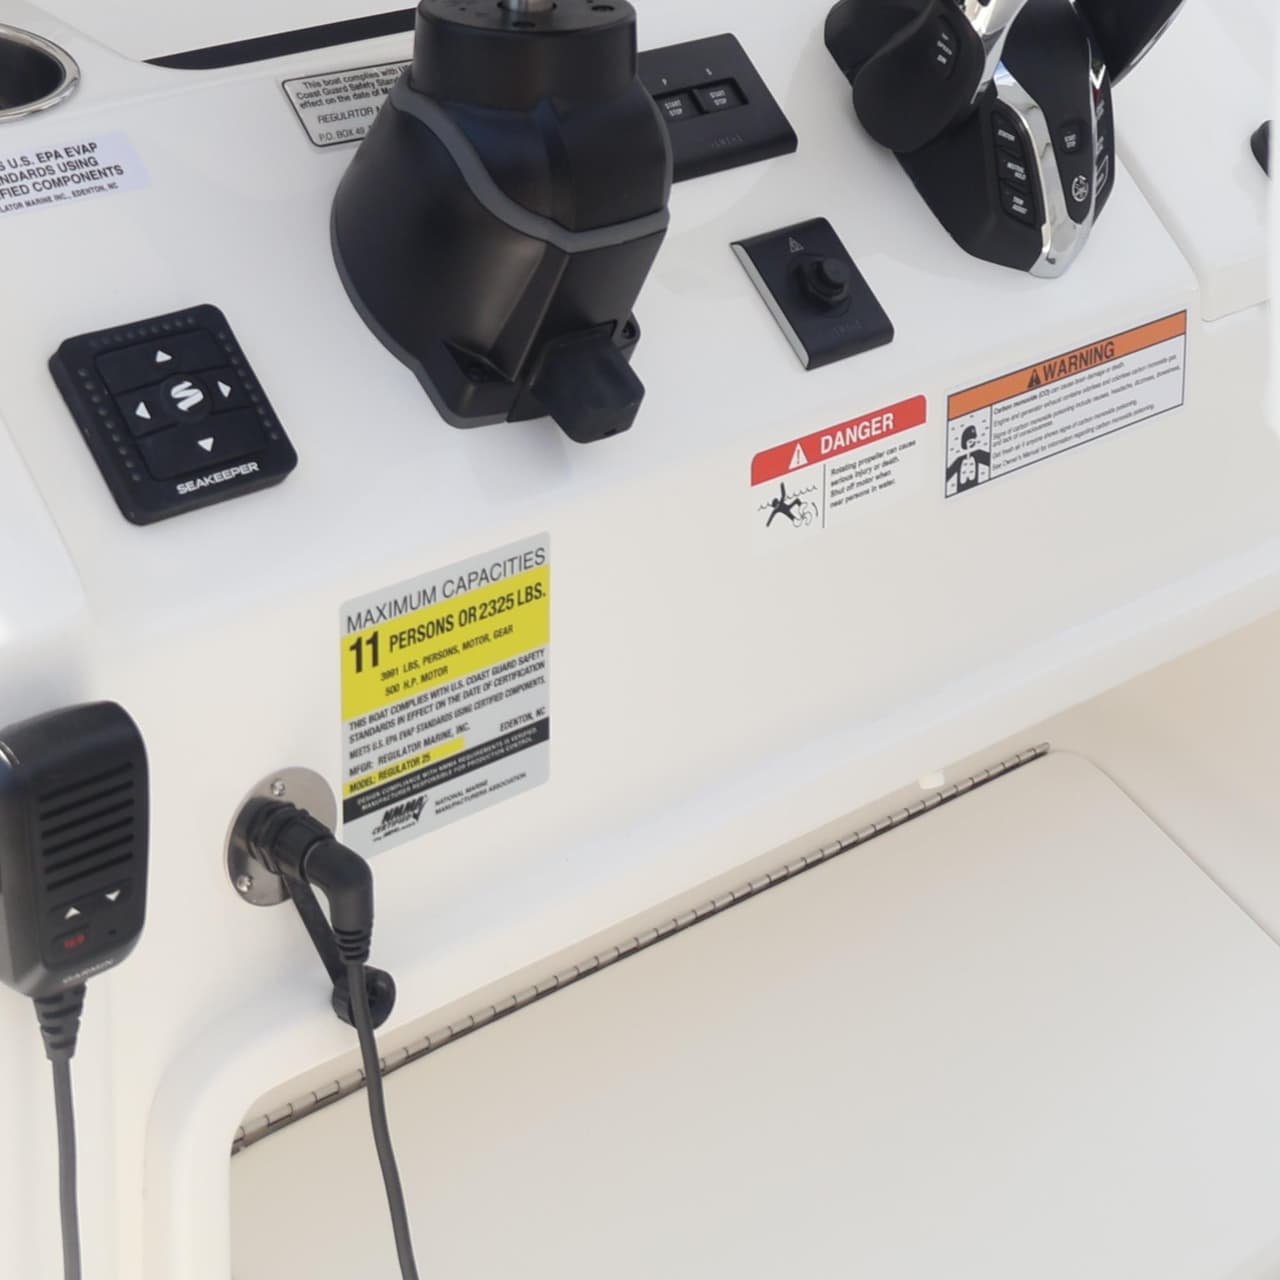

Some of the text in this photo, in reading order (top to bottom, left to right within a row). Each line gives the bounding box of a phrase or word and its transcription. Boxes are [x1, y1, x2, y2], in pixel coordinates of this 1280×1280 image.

[317, 106, 374, 123] REGULATOR
[664, 100, 682, 110] START
[7, 155, 34, 169] U.S.
[35, 149, 63, 163] EPA
[63, 142, 97, 158] EVAP
[56, 156, 98, 173] USING
[32, 165, 123, 192] COMPONENTS
[1043, 341, 1115, 382] WARNING
[820, 413, 894, 455] DANGER
[176, 462, 260, 495] SEAKEEPER
[347, 547, 545, 633] MAXIMUM CAPACITIES
[349, 582, 546, 675] 11 PERSONS OR 2325 LBS.
[349, 648, 544, 731] THIS BOAT COMPLIES WITH U.S. COAST GUARD SAFETY
[349, 660, 545, 744] STANDARDS IN EFFECT ON THE DATE OF CERTIFICATION
[349, 776, 377, 793] MODEL:
[378, 756, 420, 781] REGULATOR
[421, 752, 431, 764] 25
